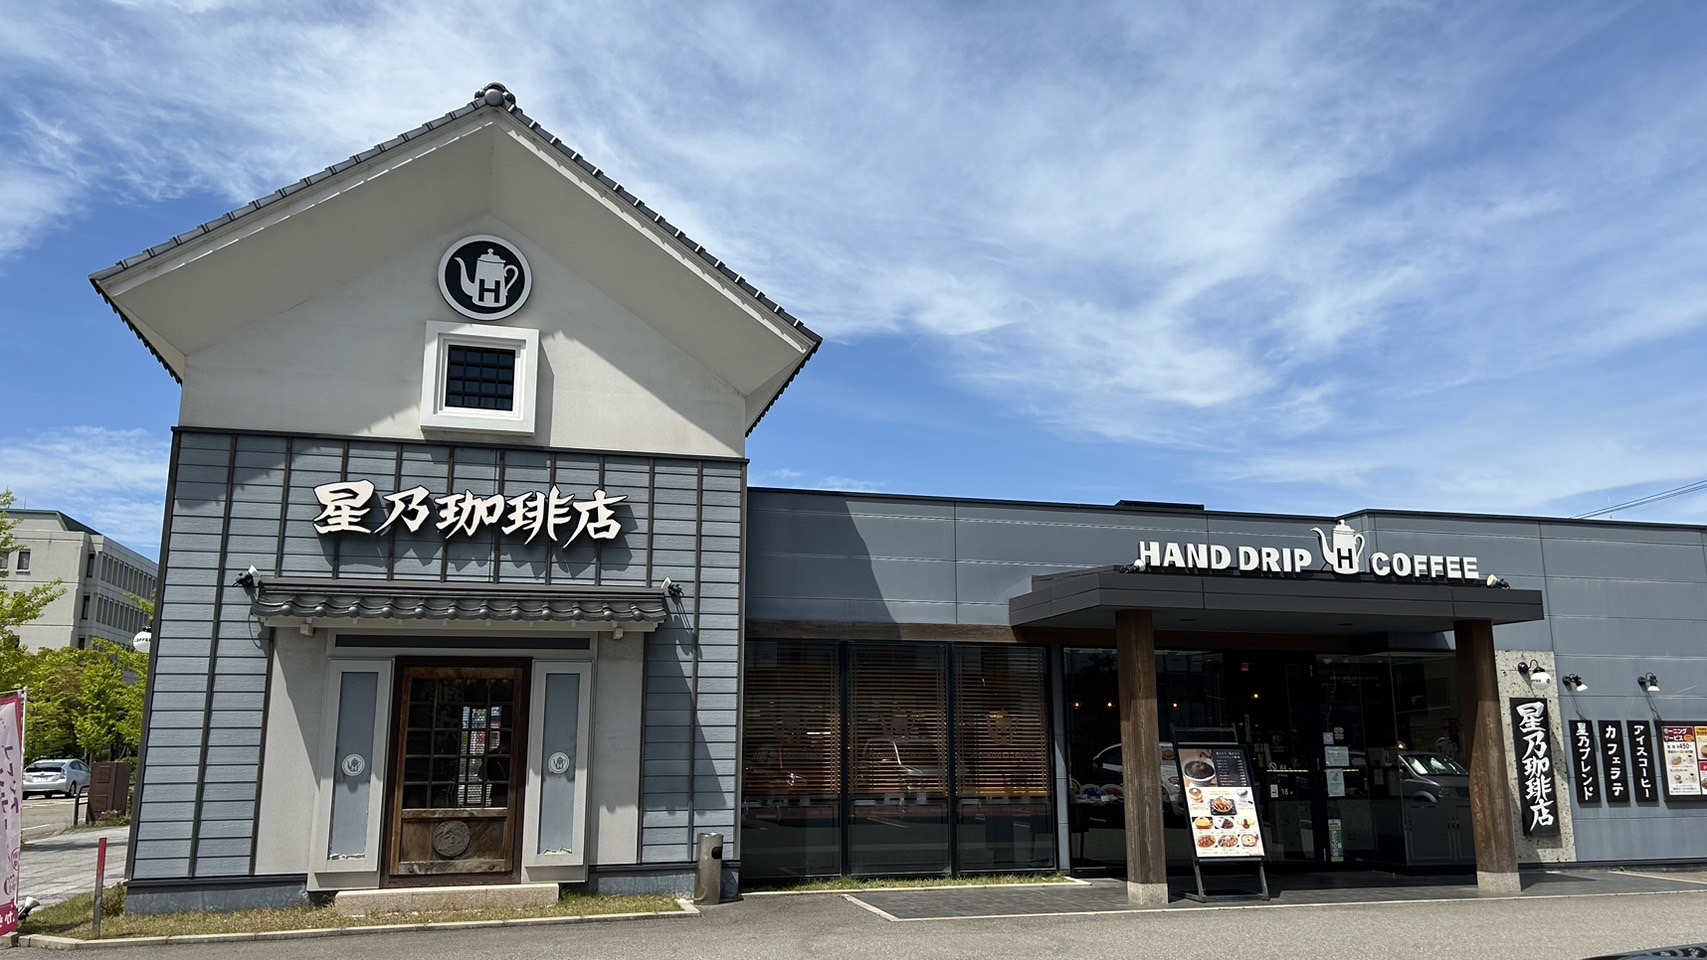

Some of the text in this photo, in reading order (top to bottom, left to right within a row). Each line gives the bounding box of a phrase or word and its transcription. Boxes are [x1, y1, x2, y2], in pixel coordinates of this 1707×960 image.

[478, 279, 501, 303] H
[313, 479, 629, 549] 星乃珈琲店
[1139, 540, 1480, 580] HAND DRIP H COFFEE
[1516, 701, 1554, 832] 星乃珈琲店
[1576, 722, 1594, 801] 星乃ブレンド
[1605, 725, 1624, 797] カフェラテ
[1633, 725, 1652, 798] アイスコーヒー
